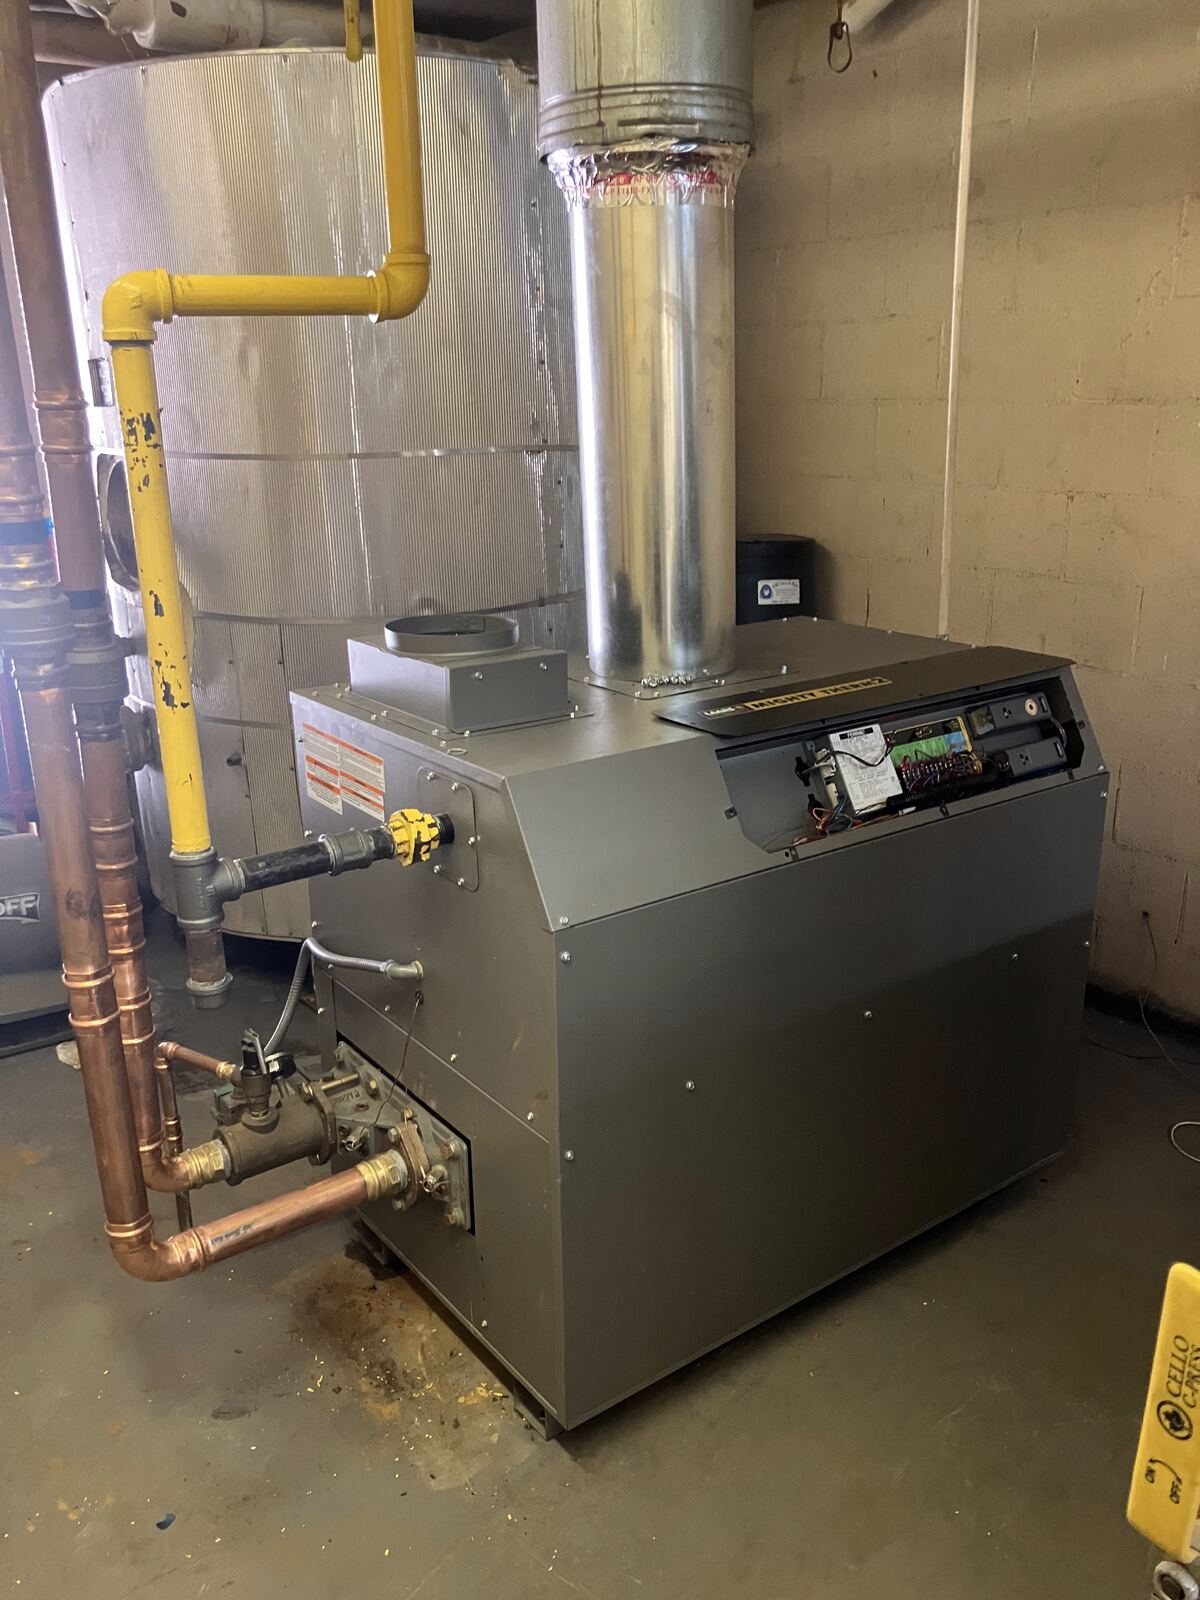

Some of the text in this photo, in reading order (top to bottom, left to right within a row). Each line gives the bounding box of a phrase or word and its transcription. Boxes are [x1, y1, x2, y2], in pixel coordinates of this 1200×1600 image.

[751, 692, 817, 709] MIGHTY
[1166, 1334, 1189, 1397] CELLO
[1145, 1466, 1156, 1484] ON
[1169, 1481, 1182, 1504] OFF
